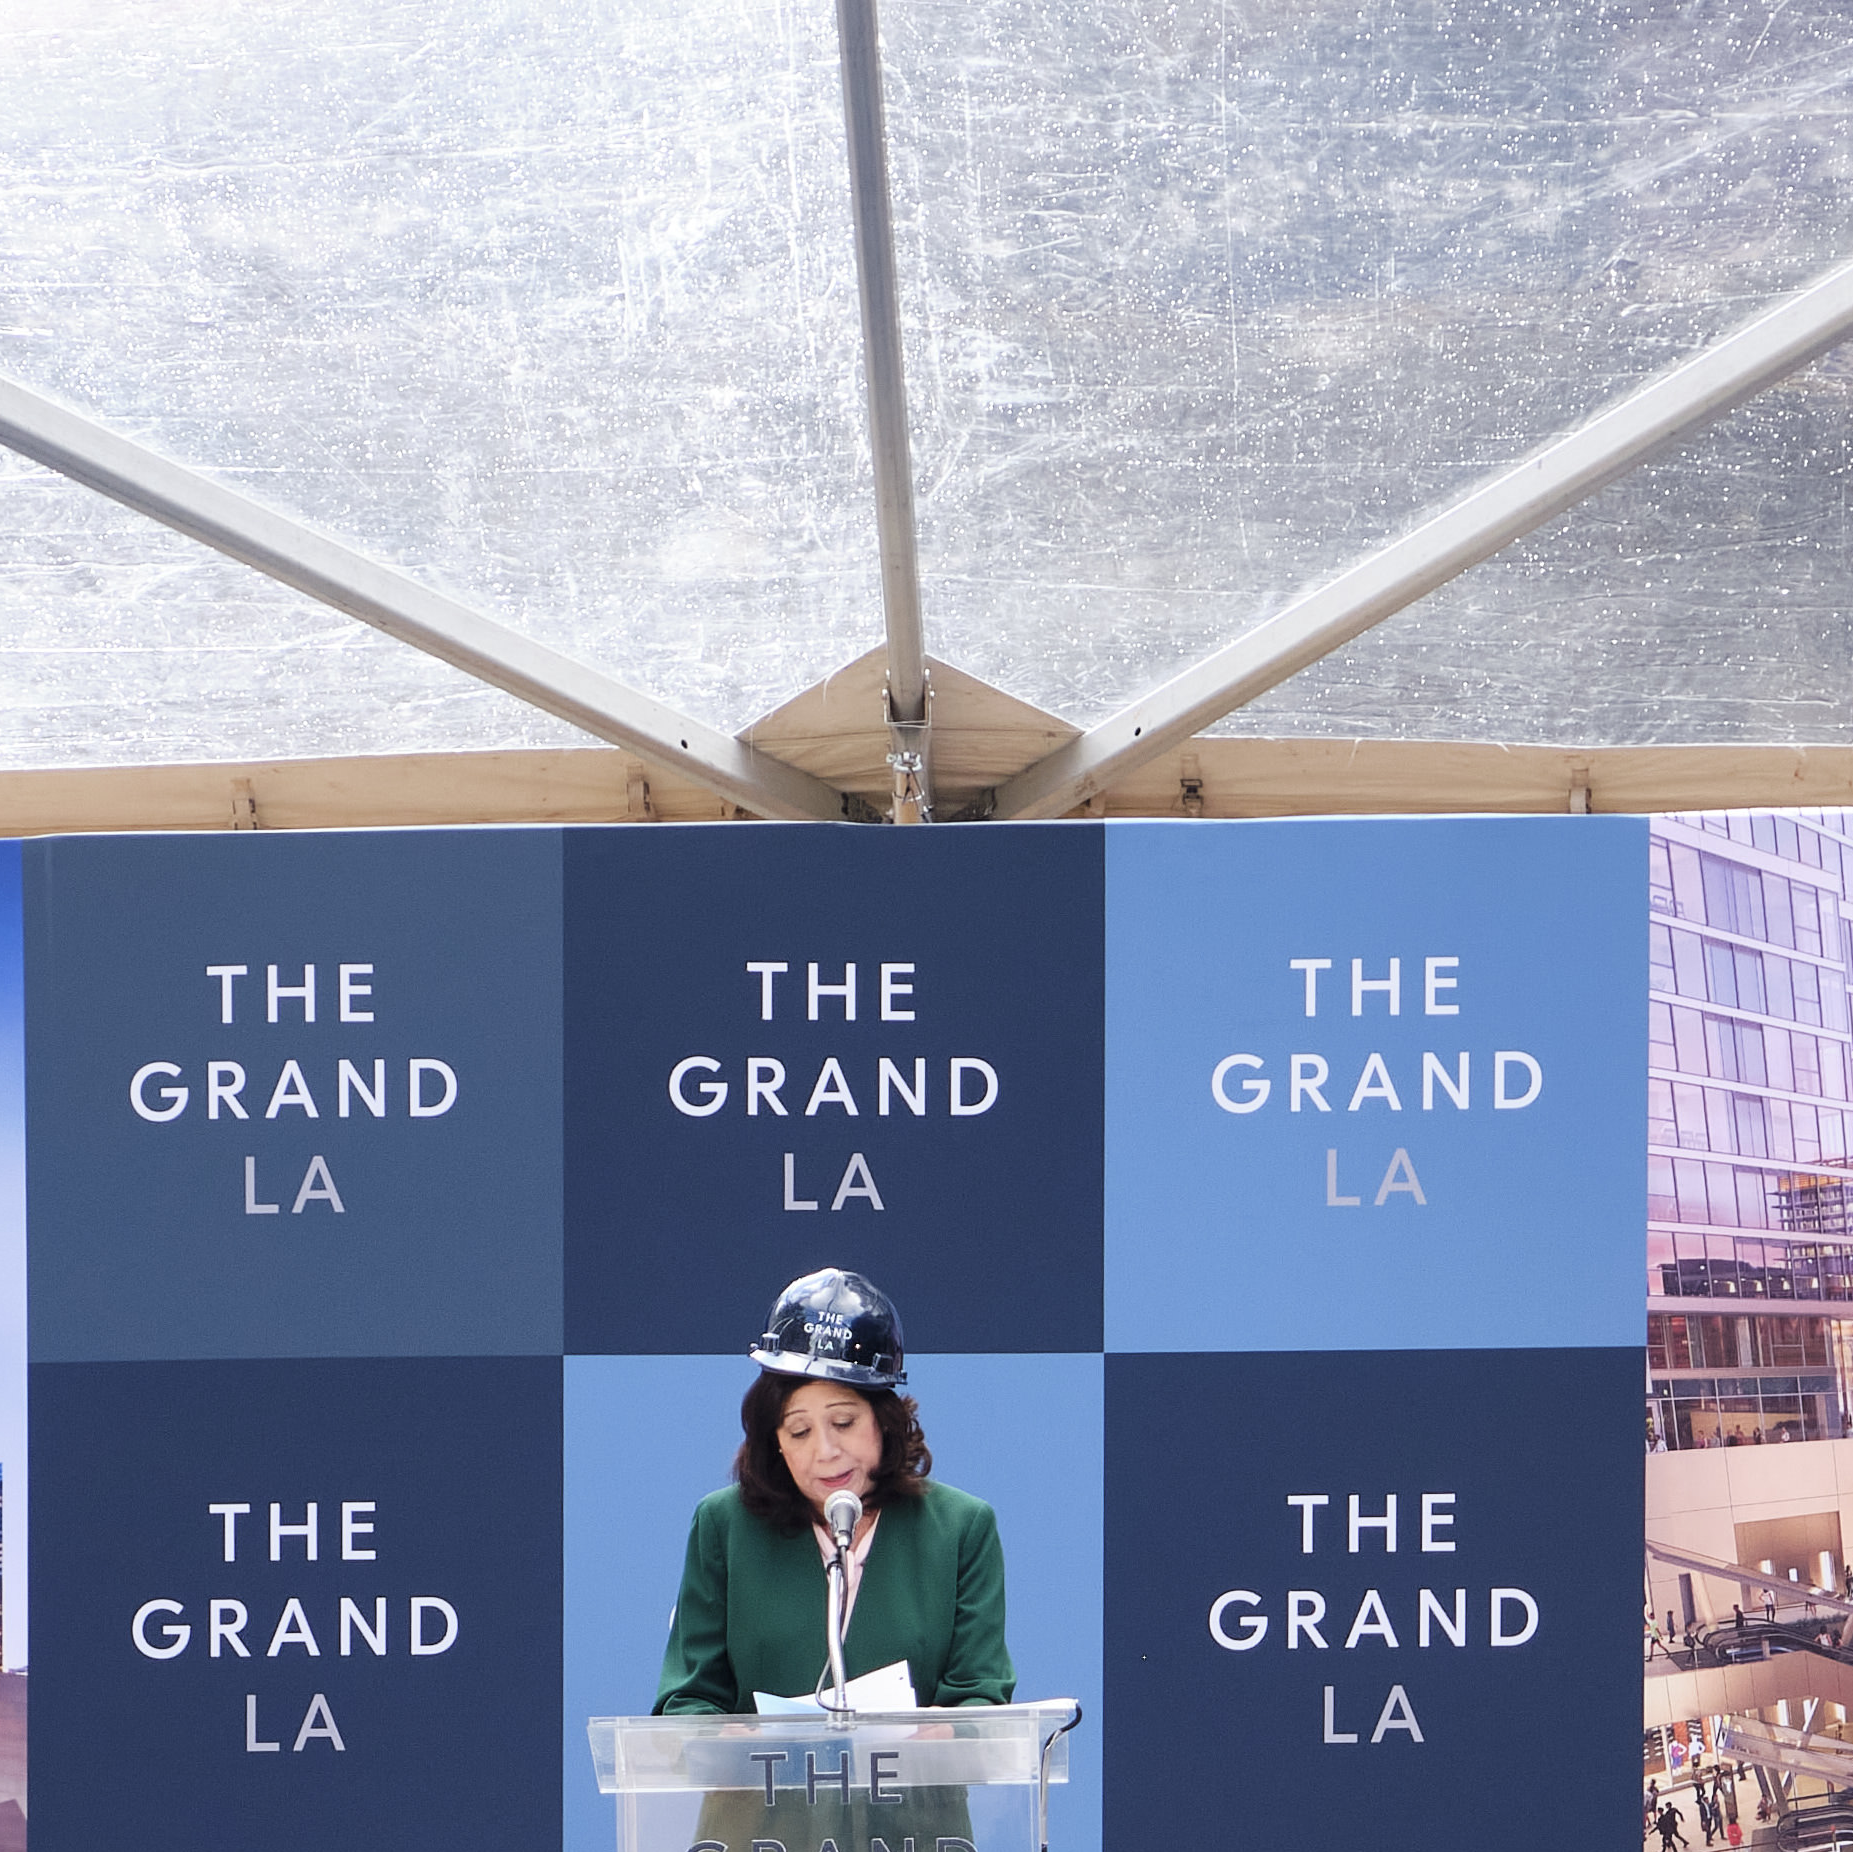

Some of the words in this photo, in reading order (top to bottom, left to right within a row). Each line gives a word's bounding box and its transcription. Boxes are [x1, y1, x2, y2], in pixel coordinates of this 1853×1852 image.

[207, 964, 374, 1023] THE
[747, 962, 915, 1021] THE
[1290, 957, 1459, 1017] THE
[130, 1059, 457, 1122] GRAND
[669, 1056, 998, 1117] GRAND
[1212, 1051, 1542, 1114] GRAND
[245, 1156, 345, 1214] LA
[784, 1153, 884, 1210] LA
[1327, 1148, 1427, 1206] LA
[803, 1322, 853, 1340] GRAND
[817, 1338, 834, 1350] LA
[818, 1311, 844, 1324] THE
[209, 1502, 376, 1562] THE
[1288, 1493, 1456, 1553] THE
[132, 1597, 458, 1659] GRAND
[1209, 1588, 1538, 1650] GRAND
[247, 1694, 345, 1752] LA
[1324, 1685, 1424, 1743] LA
[749, 1750, 903, 1806] THE
